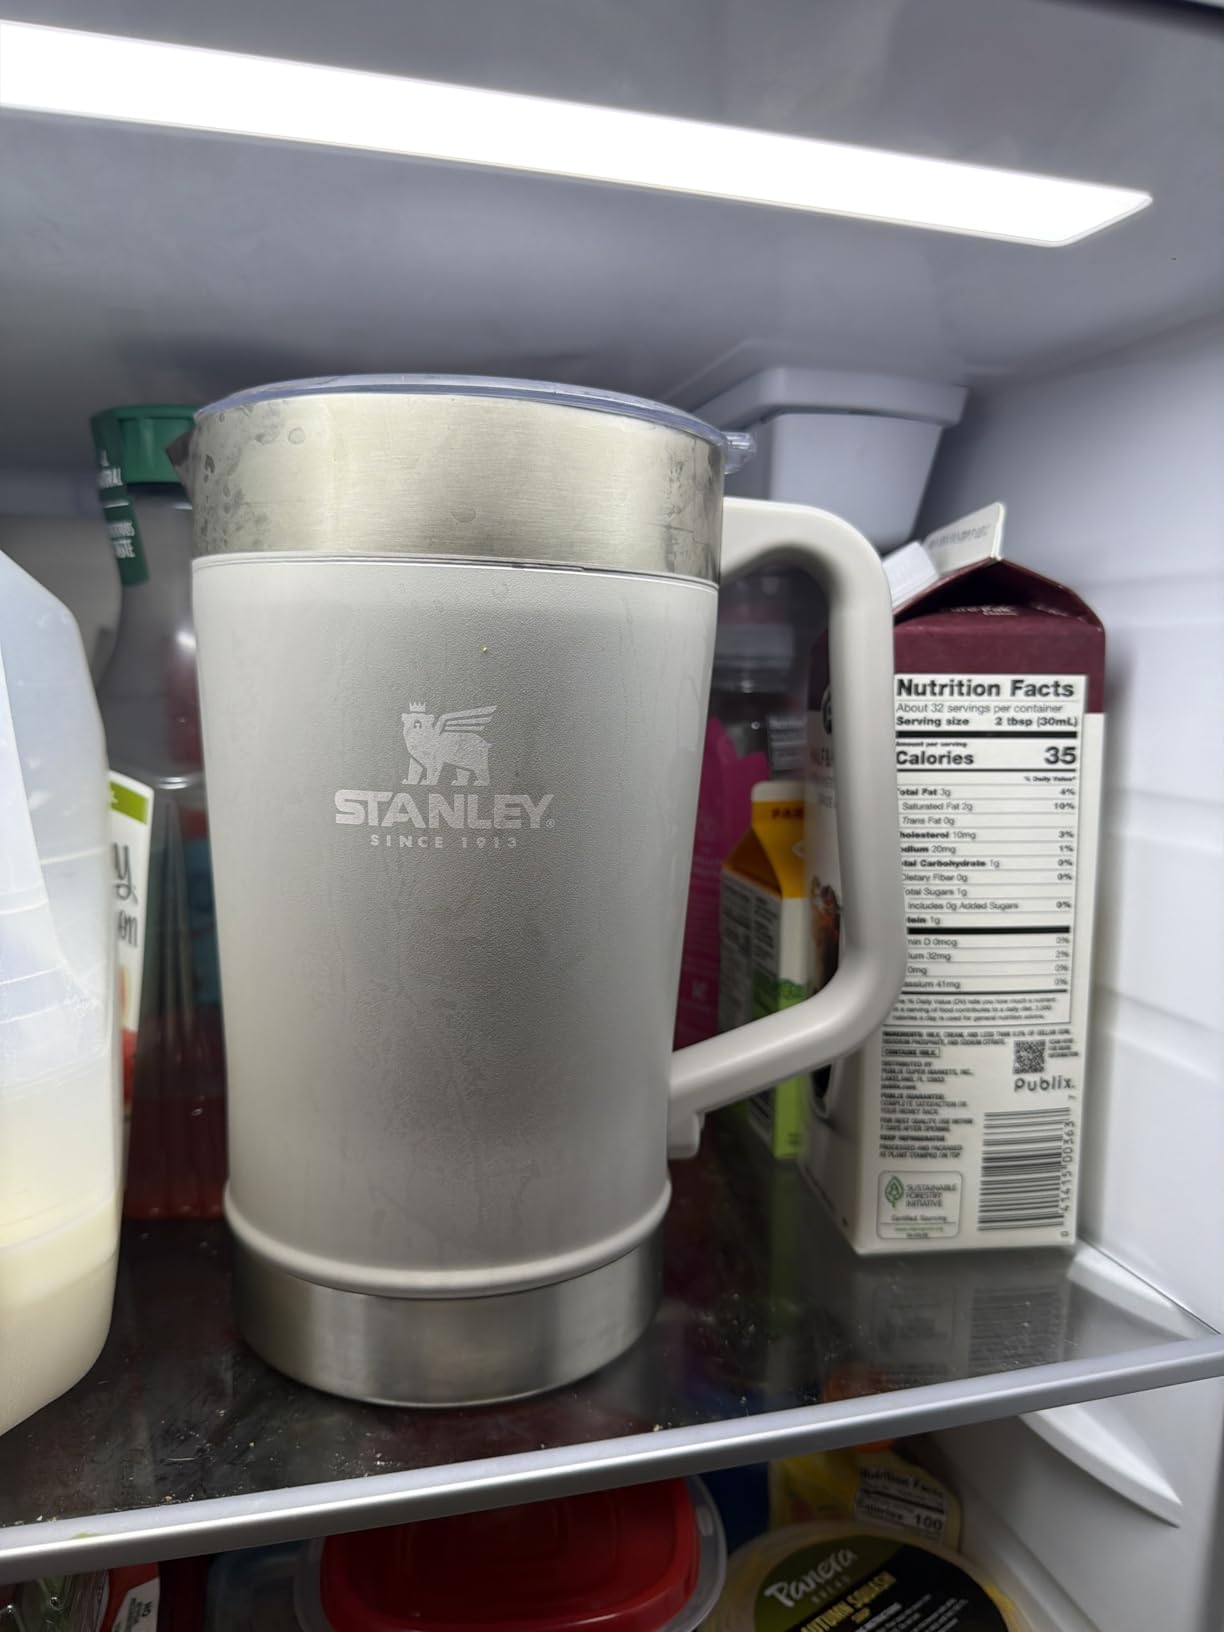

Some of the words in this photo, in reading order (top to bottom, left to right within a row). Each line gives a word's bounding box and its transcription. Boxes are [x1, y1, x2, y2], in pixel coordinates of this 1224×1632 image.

[896, 679, 1000, 697] Nutrition
[1010, 680, 1074, 697] Facts
[896, 704, 928, 713] About
[930, 704, 944, 713] 32
[947, 704, 990, 715] servings
[993, 705, 1010, 715] per
[1014, 704, 1063, 713] container
[896, 717, 941, 727] Serving
[946, 717, 969, 726] size
[994, 717, 1003, 726] 2
[1007, 717, 1033, 727] tbsp
[1036, 716, 1078, 727] (30mL)
[896, 750, 974, 765] Calories
[1044, 747, 1077, 765] 35
[921, 788, 937, 796] Fat
[902, 802, 944, 810] Saturated
[946, 802, 960, 810] Fat
[928, 816, 942, 825] Fat
[899, 831, 949, 839] holesterol
[370, 834, 443, 849] SINCE
[462, 836, 518, 849] 1913
[919, 859, 987, 868] Carbohydrate
[933, 873, 955, 881] Fiber
[904, 887, 921, 896] otal
[923, 887, 955, 897] Sugars
[959, 901, 987, 910] Added
[915, 1512, 944, 1531] 100
[763, 1548, 859, 1608] Panera
